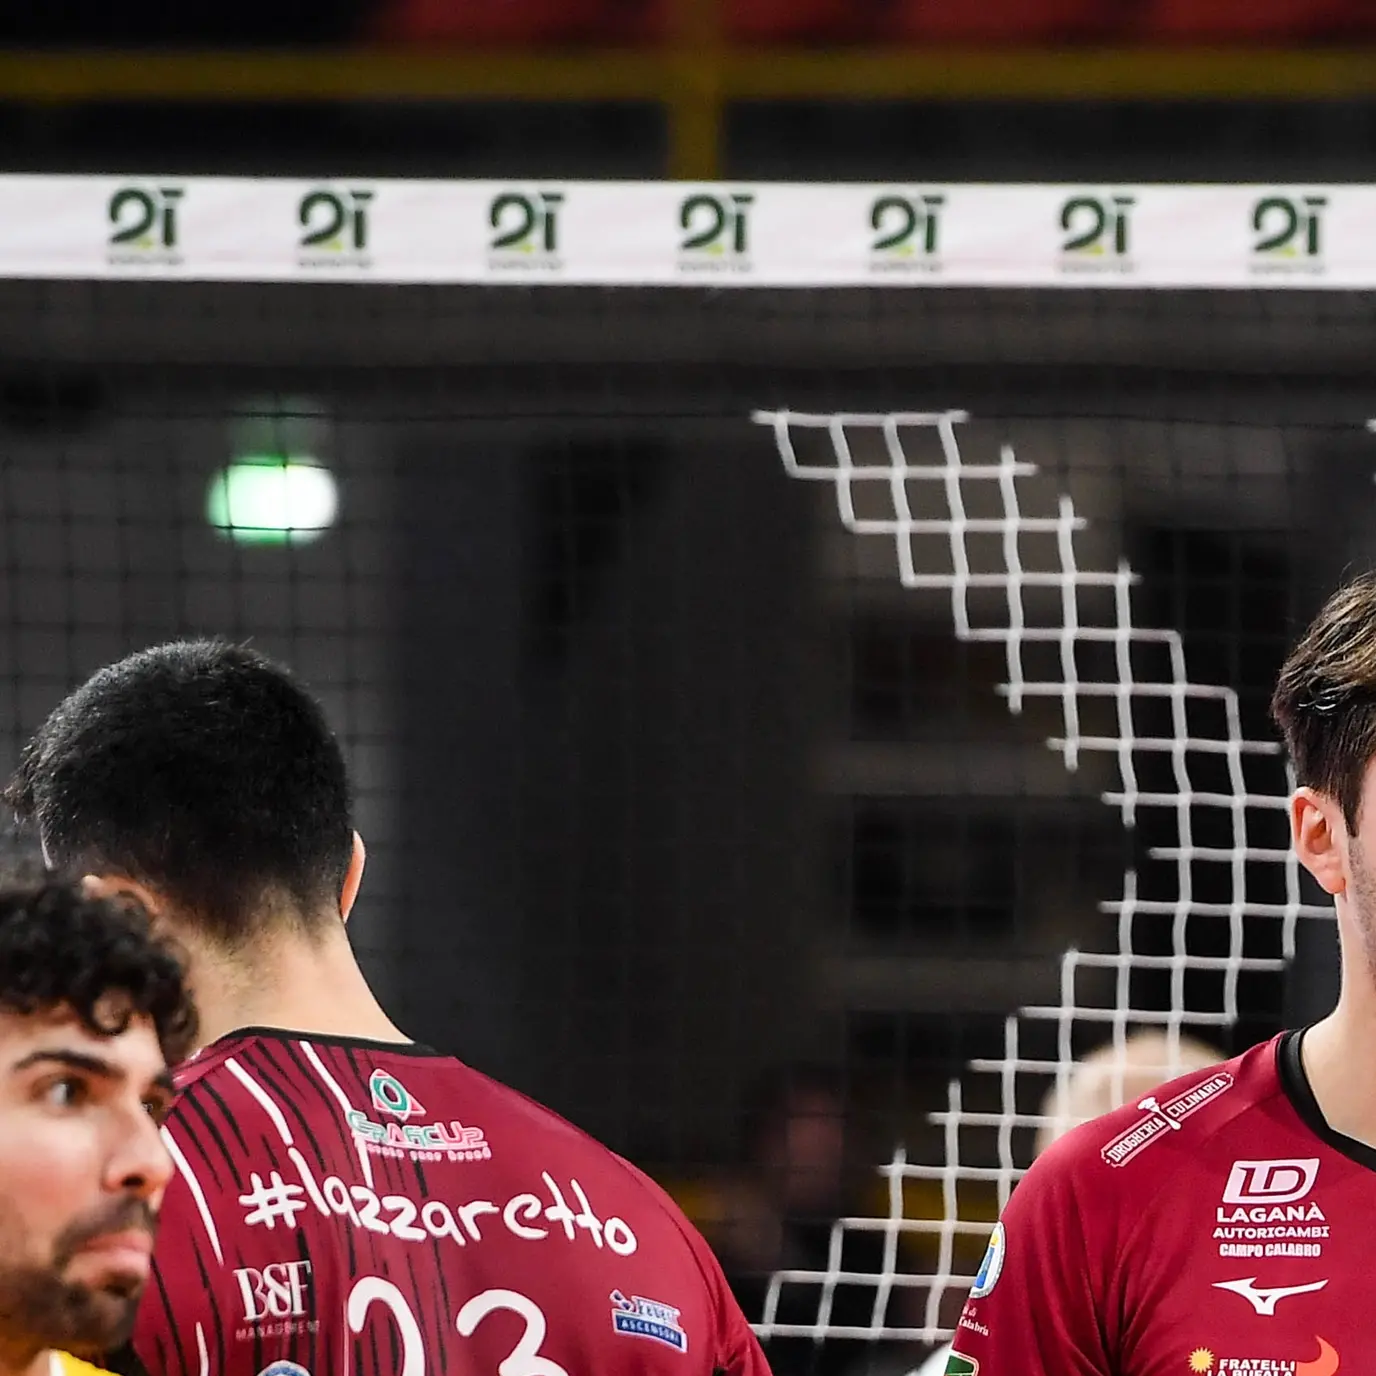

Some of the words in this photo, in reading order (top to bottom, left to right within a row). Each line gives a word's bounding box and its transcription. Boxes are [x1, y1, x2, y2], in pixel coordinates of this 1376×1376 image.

[1106, 1115, 1166, 1162] DROGHERIA
[1167, 1076, 1227, 1118] CULINARIA
[239, 1170, 638, 1256] #lazzaretto
[1216, 1202, 1326, 1224] LAGANÀ
[1212, 1226, 1330, 1240] AUTORICAMBI
[1219, 1243, 1264, 1258] CAMPO
[1265, 1242, 1322, 1258] CALABRO
[1219, 1359, 1296, 1372] FRATELLI
